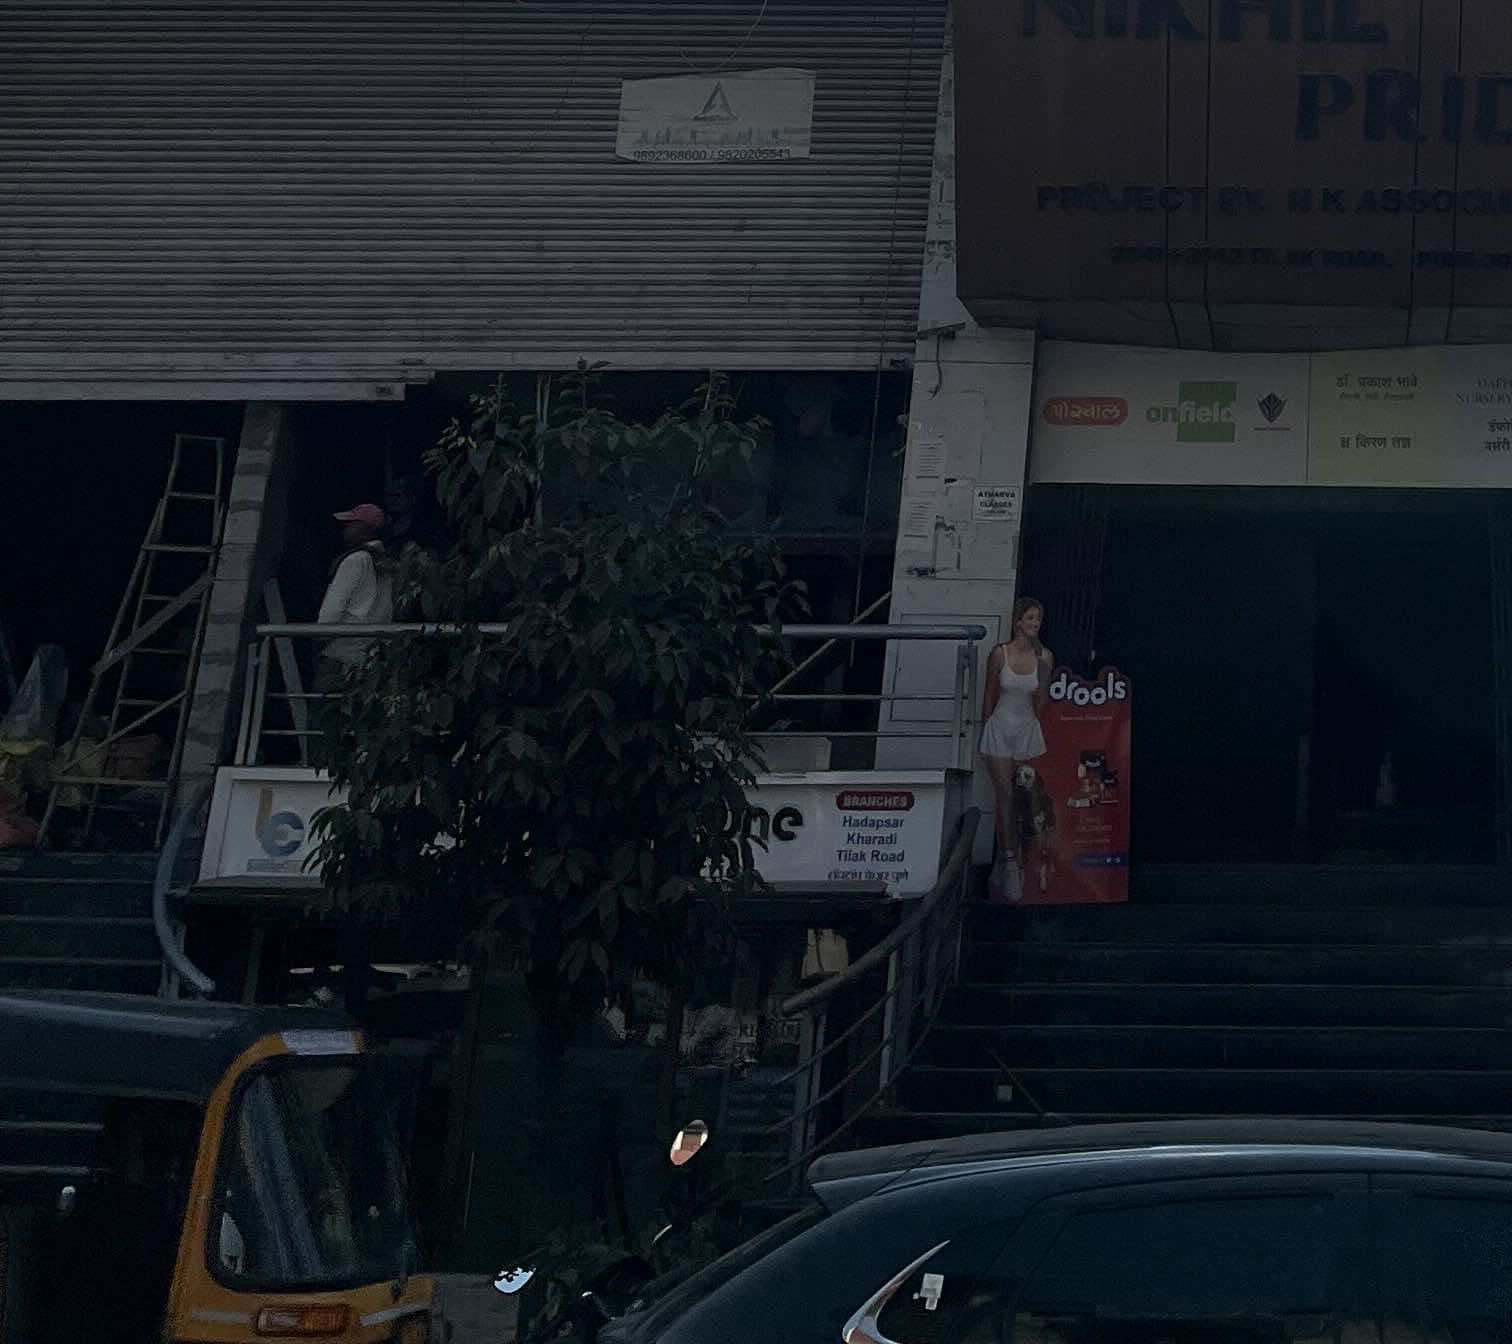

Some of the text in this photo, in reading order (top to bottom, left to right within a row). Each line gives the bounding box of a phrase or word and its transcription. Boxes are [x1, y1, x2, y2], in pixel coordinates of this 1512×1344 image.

[1036, 182, 1207, 213] PROJECT
[1049, 671, 1127, 706] drools
[842, 815, 905, 830] Hadapsar
[846, 831, 898, 846] Kharadi
[835, 849, 906, 863] Tilak Road
